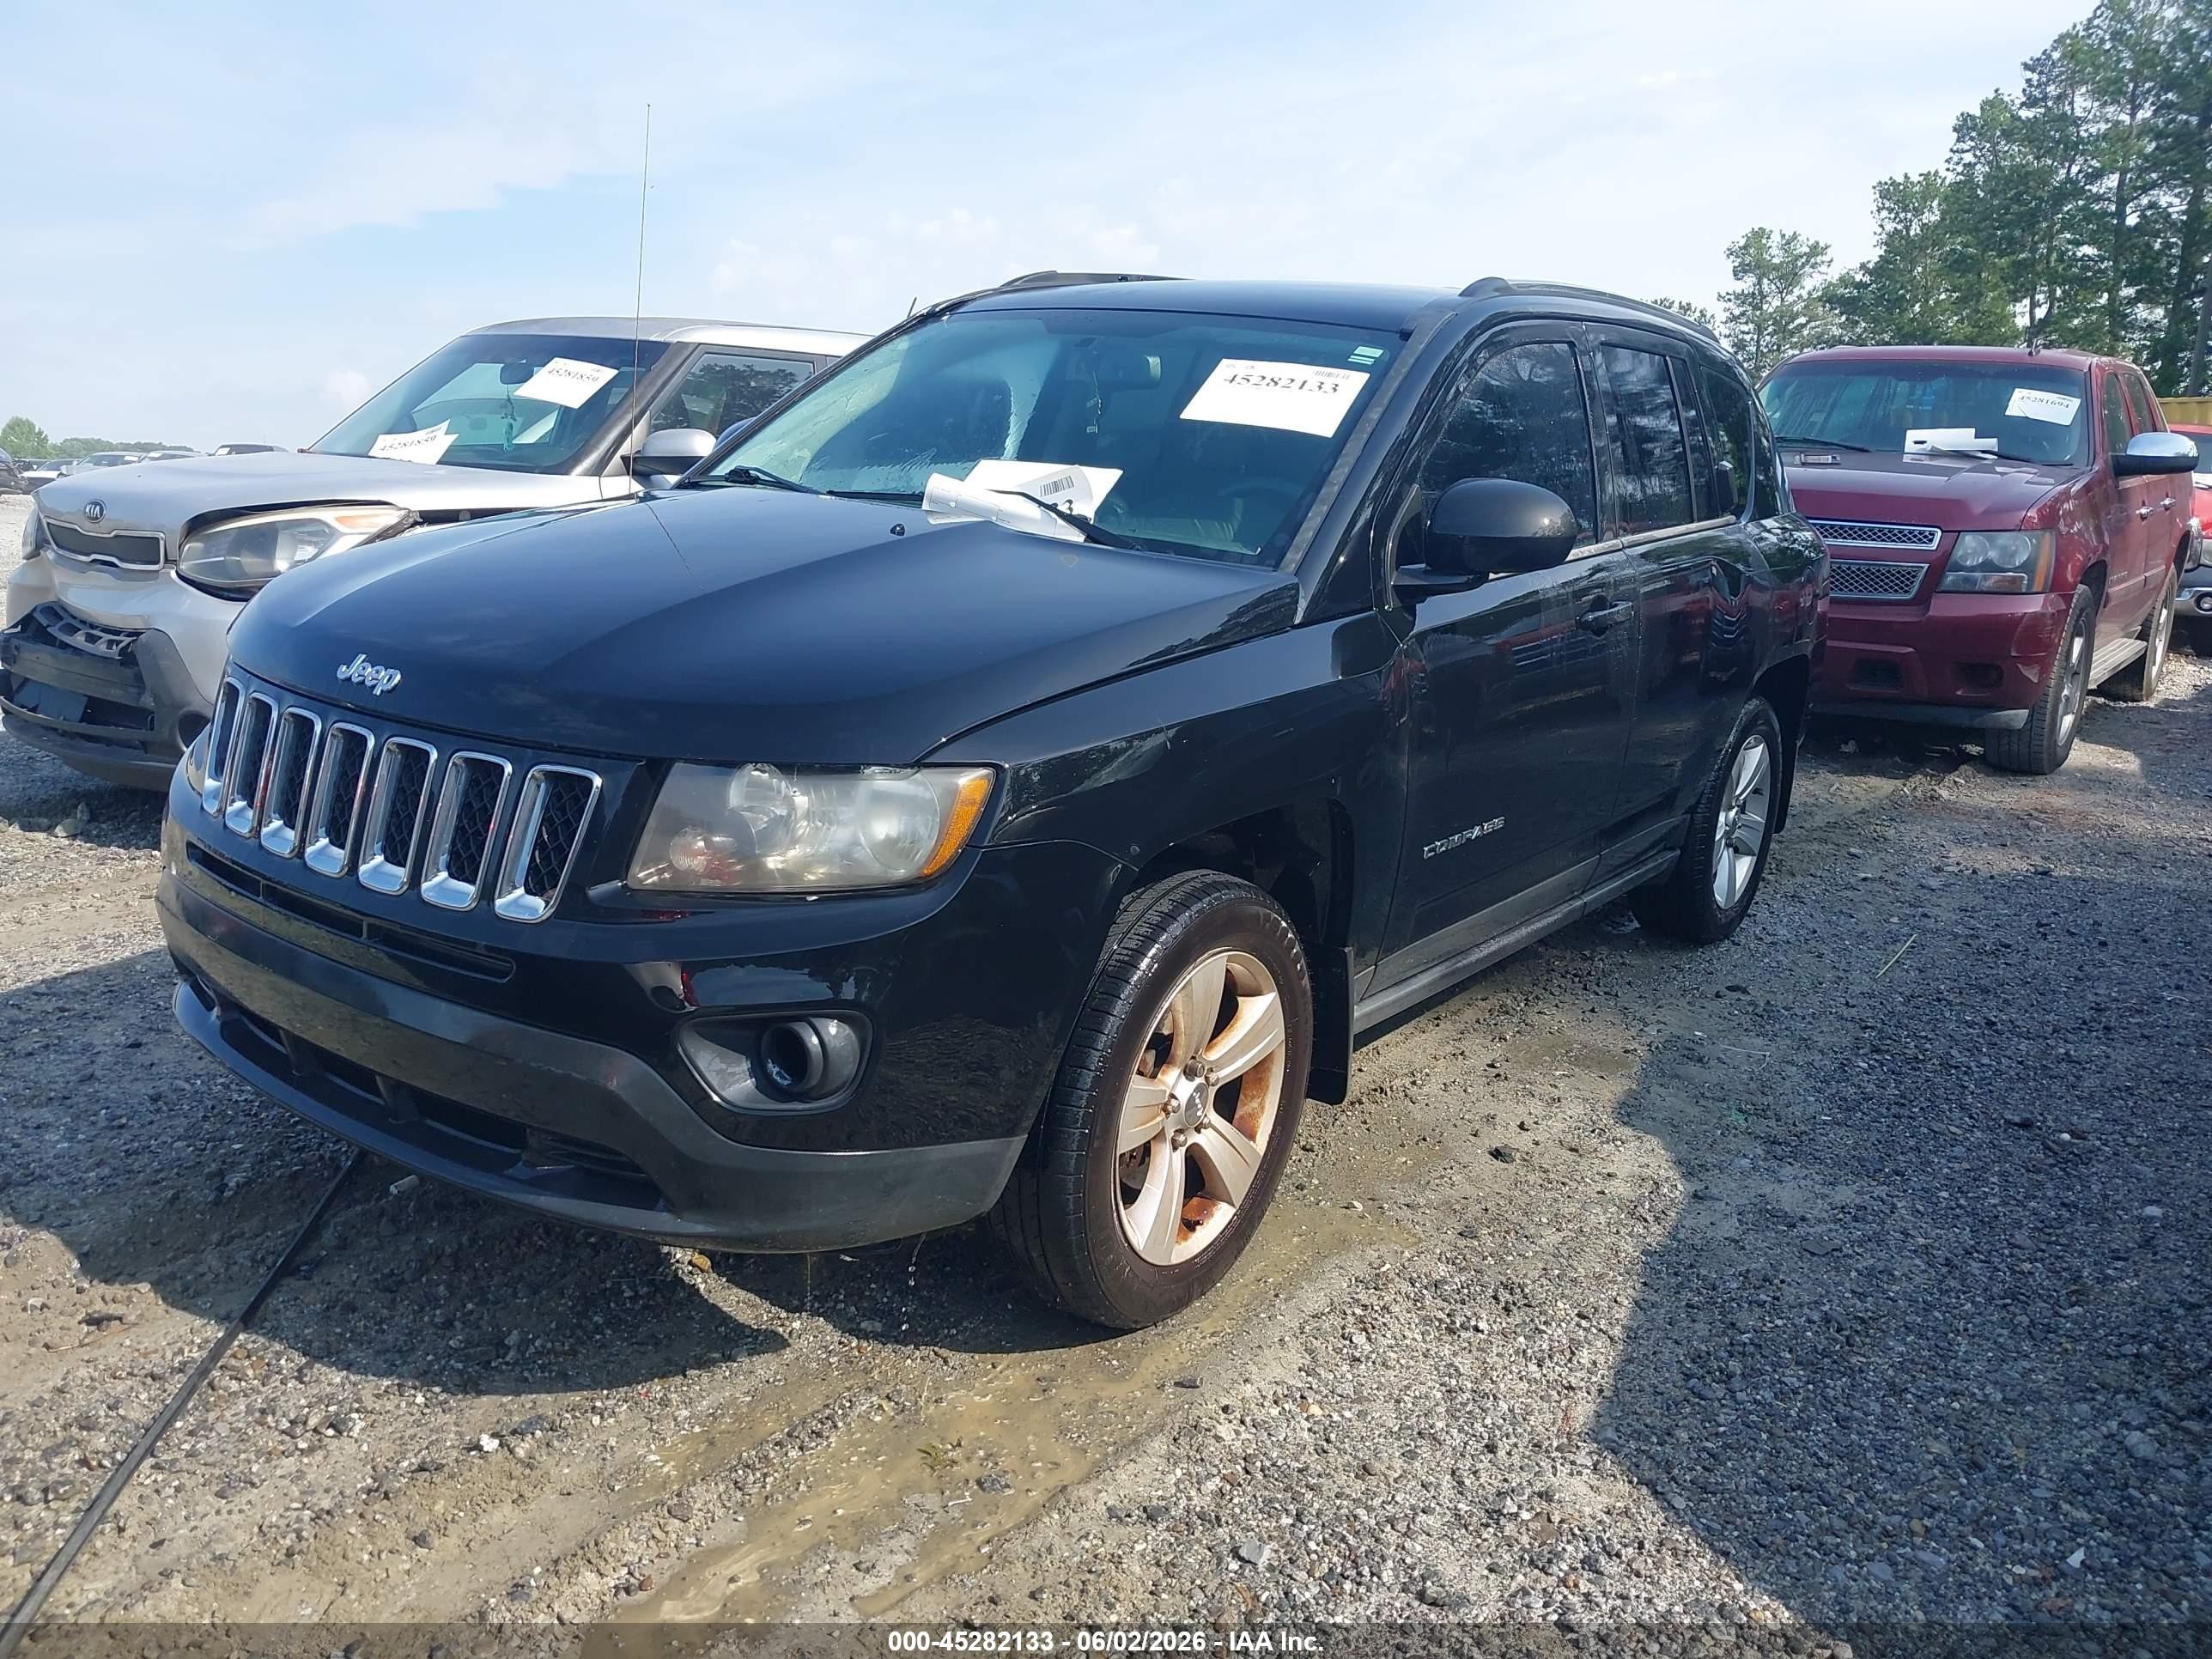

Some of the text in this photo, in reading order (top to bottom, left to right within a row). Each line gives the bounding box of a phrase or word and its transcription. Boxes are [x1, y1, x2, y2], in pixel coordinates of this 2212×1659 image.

[1224, 374, 1340, 394] 45282133
[85, 503, 100, 519] KIA
[337, 653, 402, 696] Jeep
[1422, 817, 1505, 860] COMPASS
